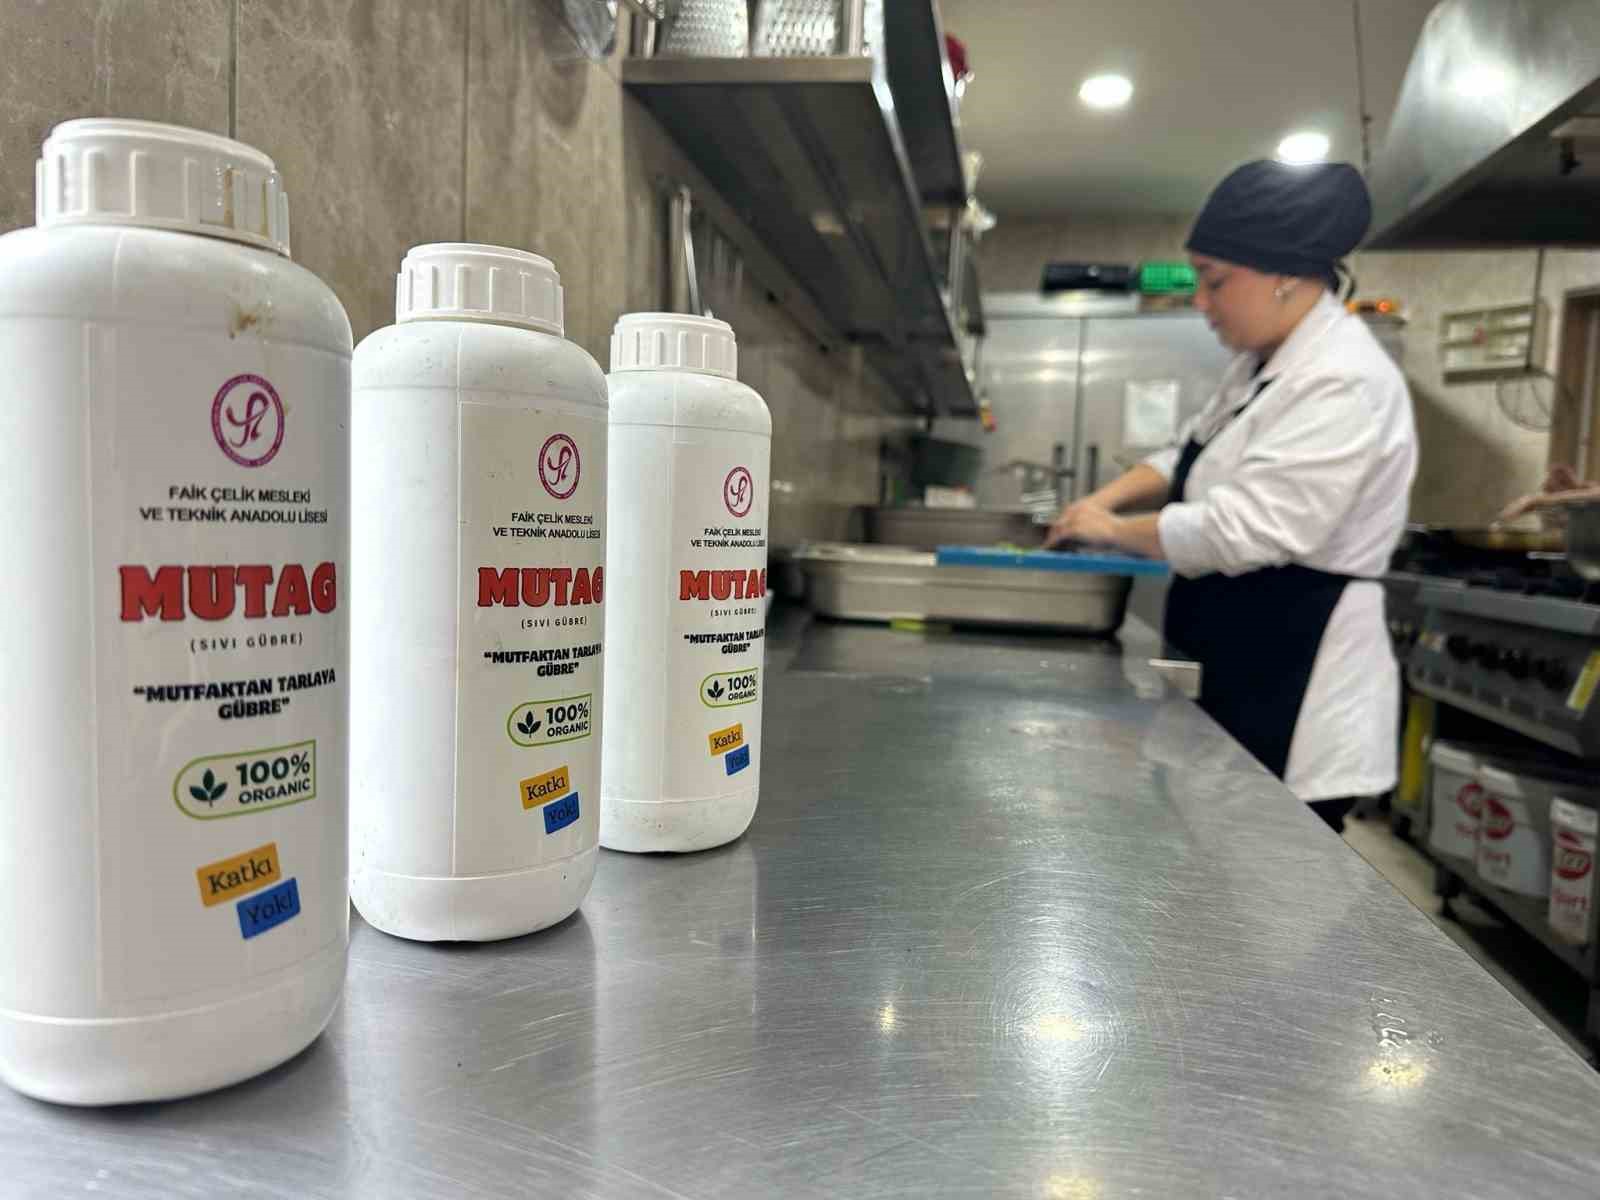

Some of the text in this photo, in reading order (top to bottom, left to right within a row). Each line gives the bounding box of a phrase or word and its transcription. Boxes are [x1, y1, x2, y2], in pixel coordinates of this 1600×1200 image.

[169, 484, 311, 505] FAİK ÇELİK MESLEKİ
[140, 505, 328, 524] VE TEKNİK ANADOLU LİSESİ
[511, 511, 535, 524] FAİK
[537, 513, 562, 526] ÇELİK
[492, 527, 507, 537] VE
[510, 525, 547, 538] TEKNİK
[548, 528, 585, 539] ANADOLU
[690, 539, 701, 548] VE
[702, 537, 730, 548] TEKNİK
[118, 562, 337, 622] MUTAG
[477, 566, 604, 608] MUTAG
[521, 615, 588, 630] (SIVI GÜBRE)
[190, 631, 303, 653] (SIVI GÜBRE)
[484, 648, 570, 664] “MUTFAKTAN
[537, 662, 579, 678] GÜBRE”
[133, 668, 336, 703] “MUTFAKTAN TARLAYA
[728, 674, 756, 692] 100%
[218, 698, 290, 720] GÜBRE”
[546, 702, 589, 725] 100%
[547, 720, 589, 738] ORGANIC
[236, 751, 311, 786] 100%
[238, 777, 311, 805] ORGANIC
[526, 775, 566, 801] Katkı
[207, 858, 275, 895] Katkı
